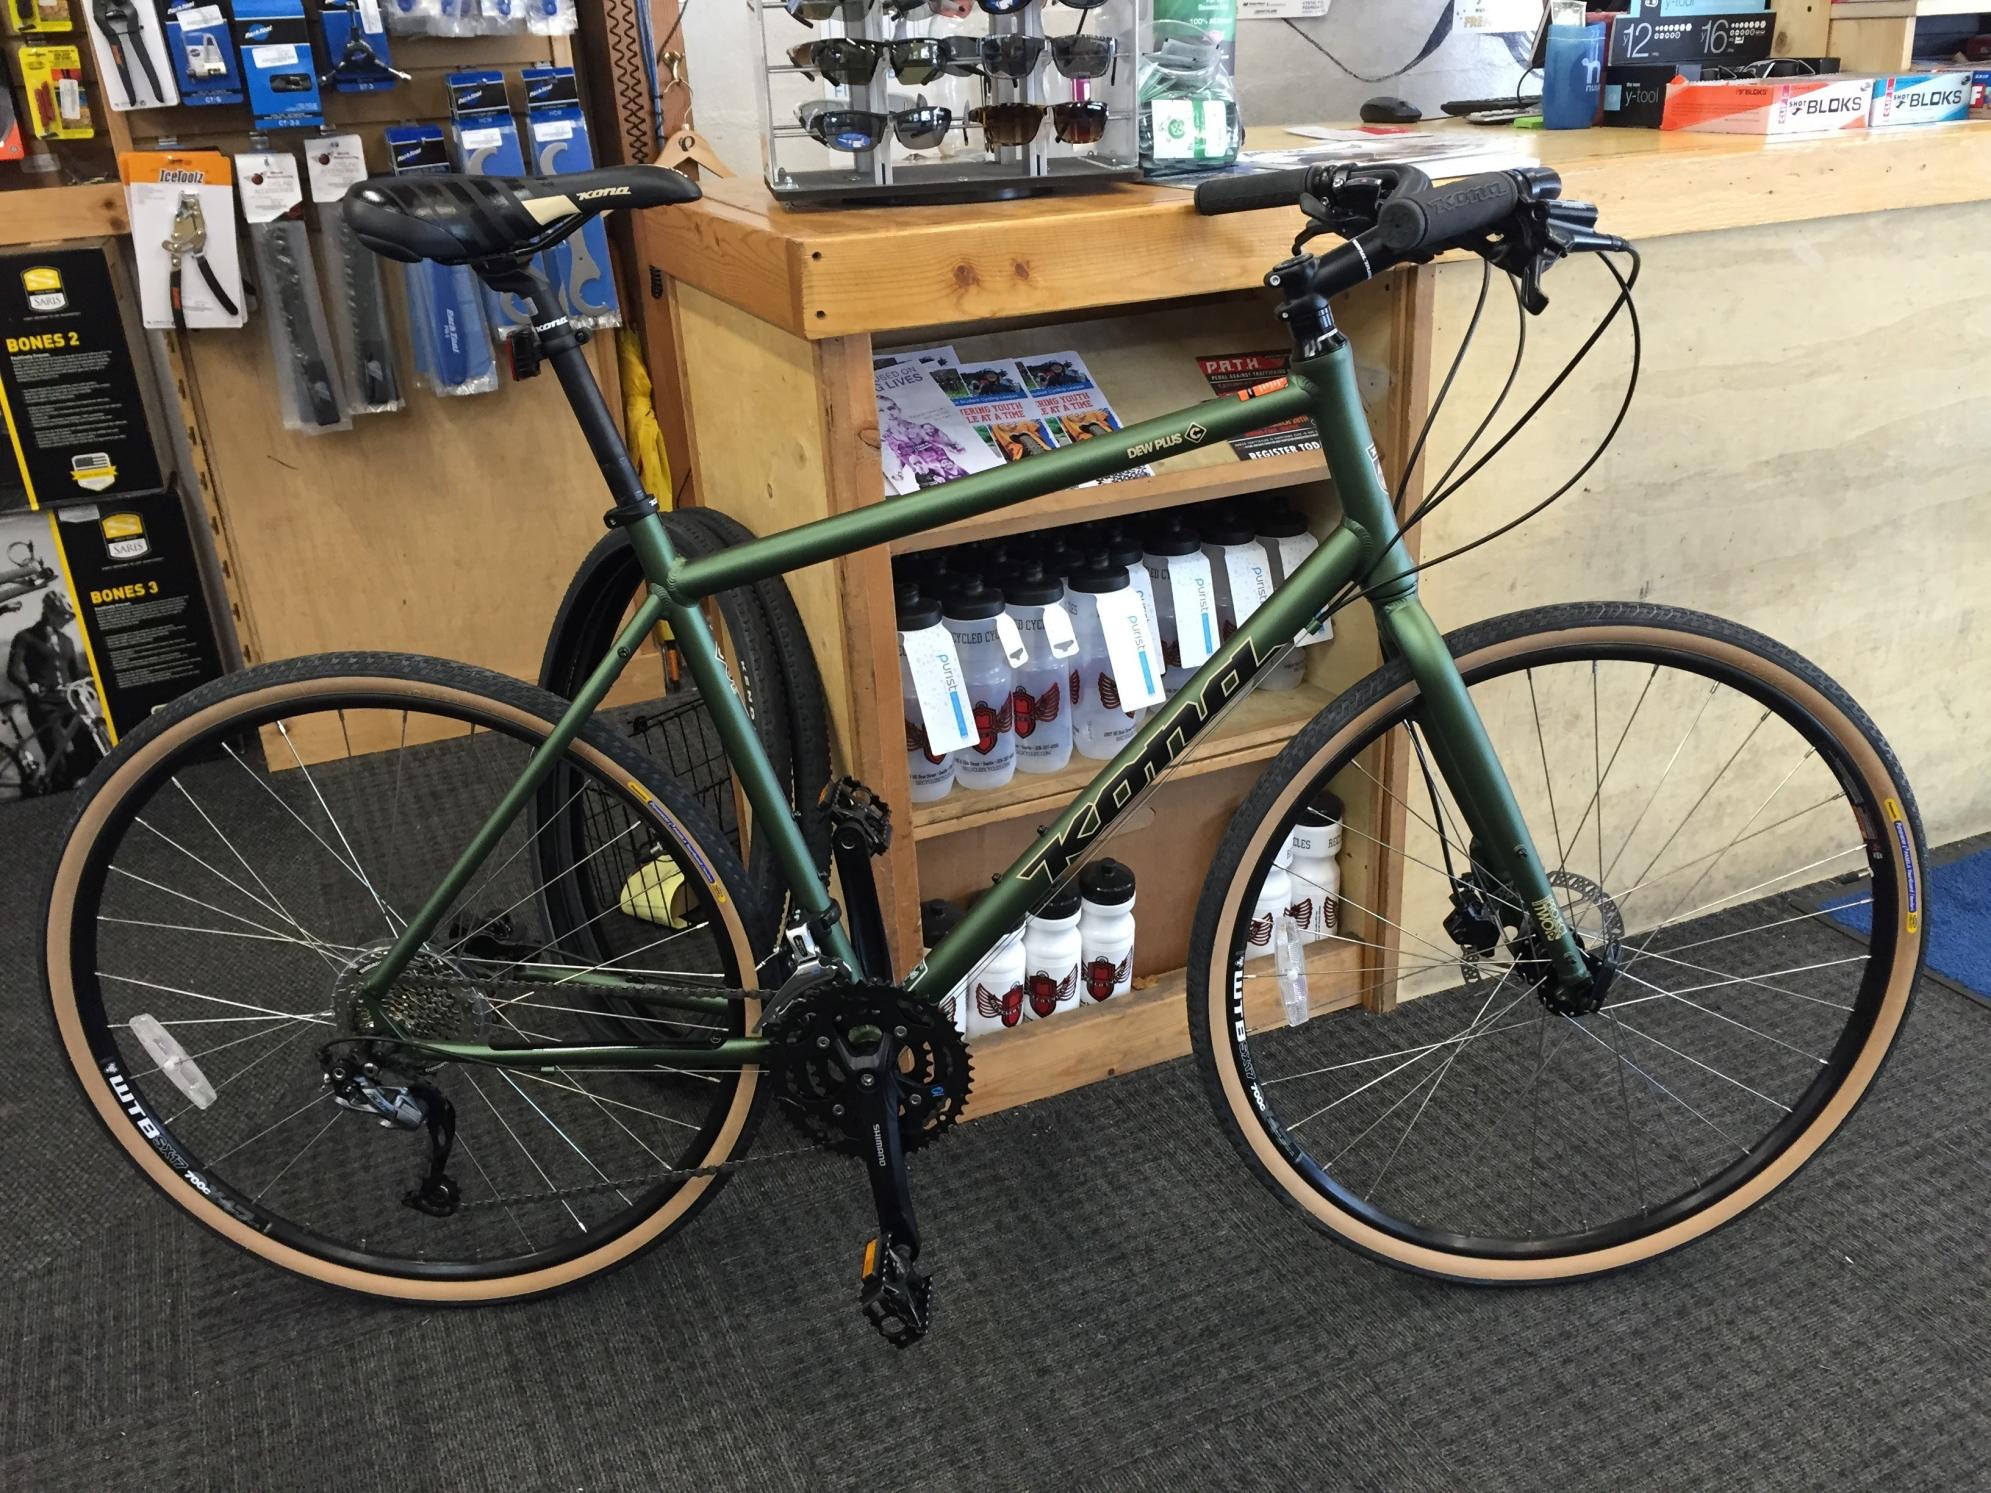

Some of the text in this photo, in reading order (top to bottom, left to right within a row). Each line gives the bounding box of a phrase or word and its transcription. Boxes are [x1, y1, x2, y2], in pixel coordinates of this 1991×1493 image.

[1625, 88, 1660, 106] y-tool
[1806, 97, 1862, 115] BLOKS
[1909, 90, 1962, 108] BLOKS
[159, 170, 204, 184] IceToolz
[5, 331, 80, 353] BONES 2
[885, 373, 923, 390] LIVES
[991, 401, 1024, 413] YOUTH
[1058, 392, 1090, 404] YOUTH
[1072, 400, 1094, 411] TIME
[1002, 410, 1026, 420] TIME
[1126, 433, 1183, 459] DEW PLUS
[1248, 445, 1296, 461] REGISTER
[90, 581, 160, 604] BONES 3
[1194, 577, 1209, 613] purist
[1127, 615, 1146, 651] purist
[936, 654, 958, 693] purist
[1233, 970, 1247, 1042] WTB
[110, 1074, 161, 1139] WTB
[873, 1123, 886, 1167] SHIMANO
